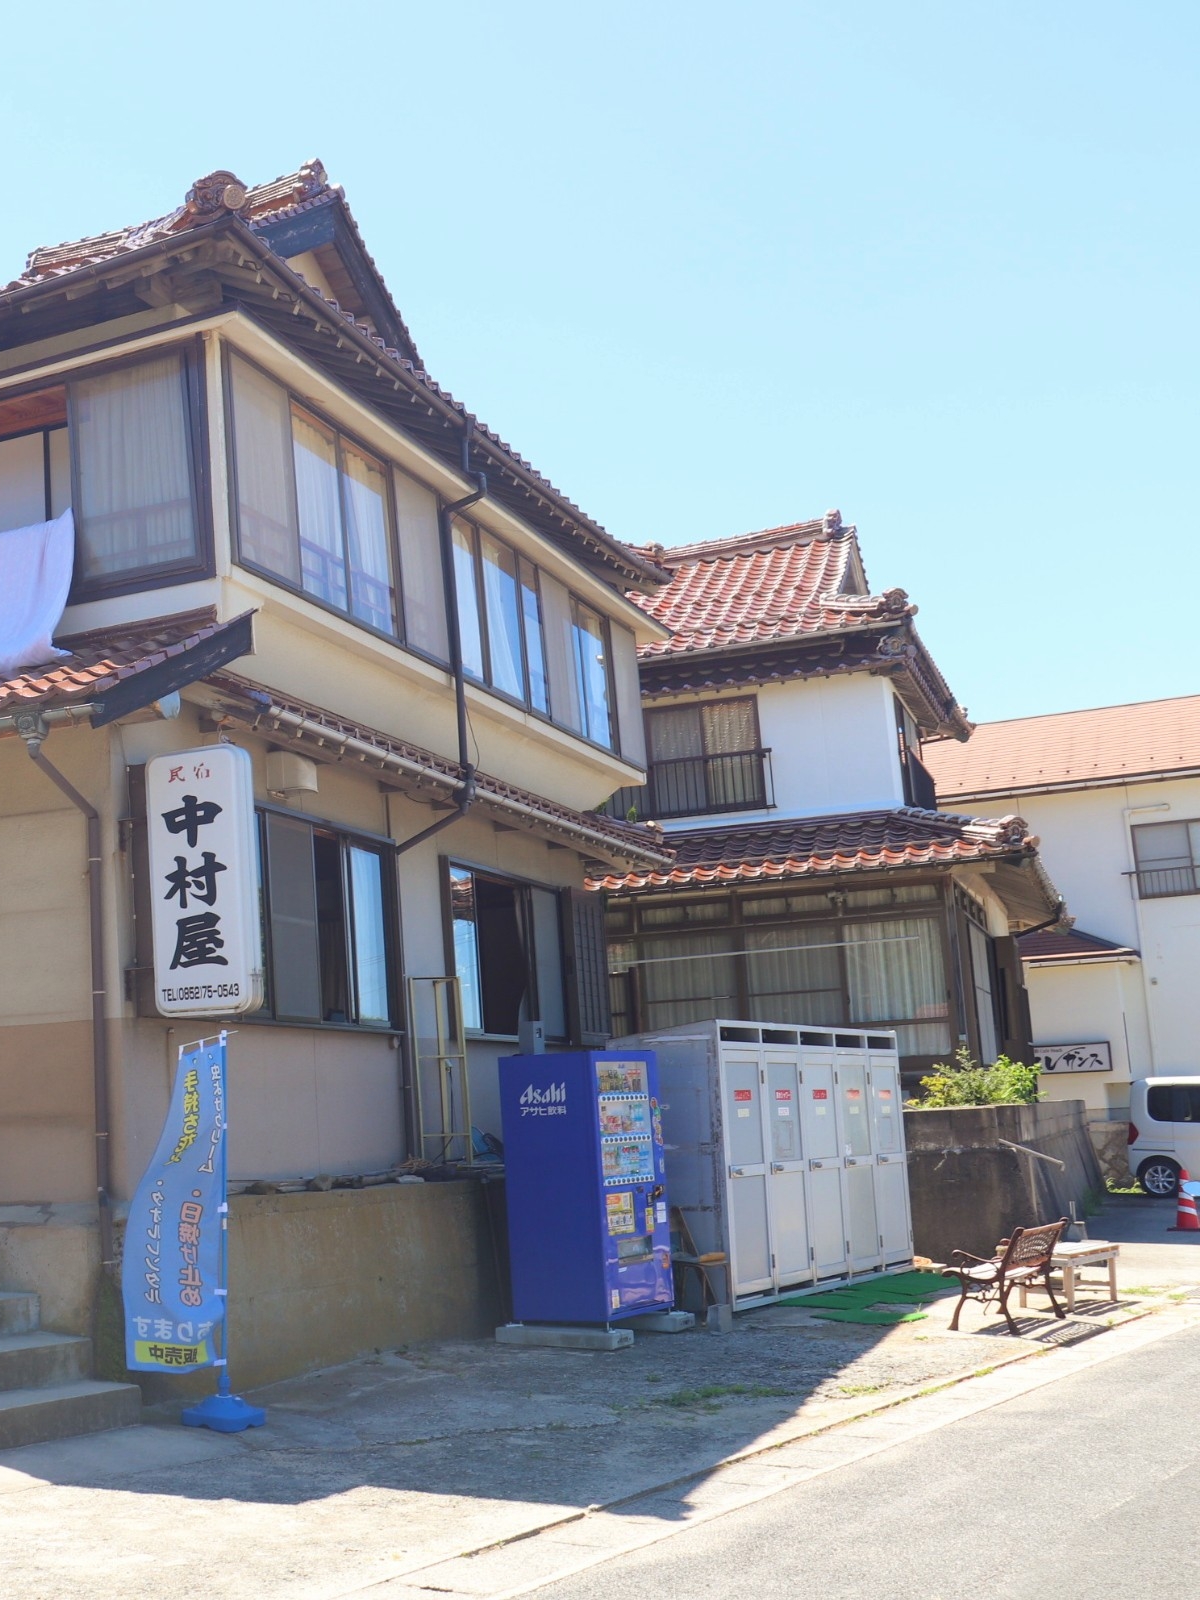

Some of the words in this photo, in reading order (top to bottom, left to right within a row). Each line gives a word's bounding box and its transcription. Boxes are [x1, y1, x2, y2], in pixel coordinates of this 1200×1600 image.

[161, 794, 228, 970] 中村屋
[519, 1081, 567, 1105] Asahi
[519, 1105, 567, 1117] アサヒ飲料
